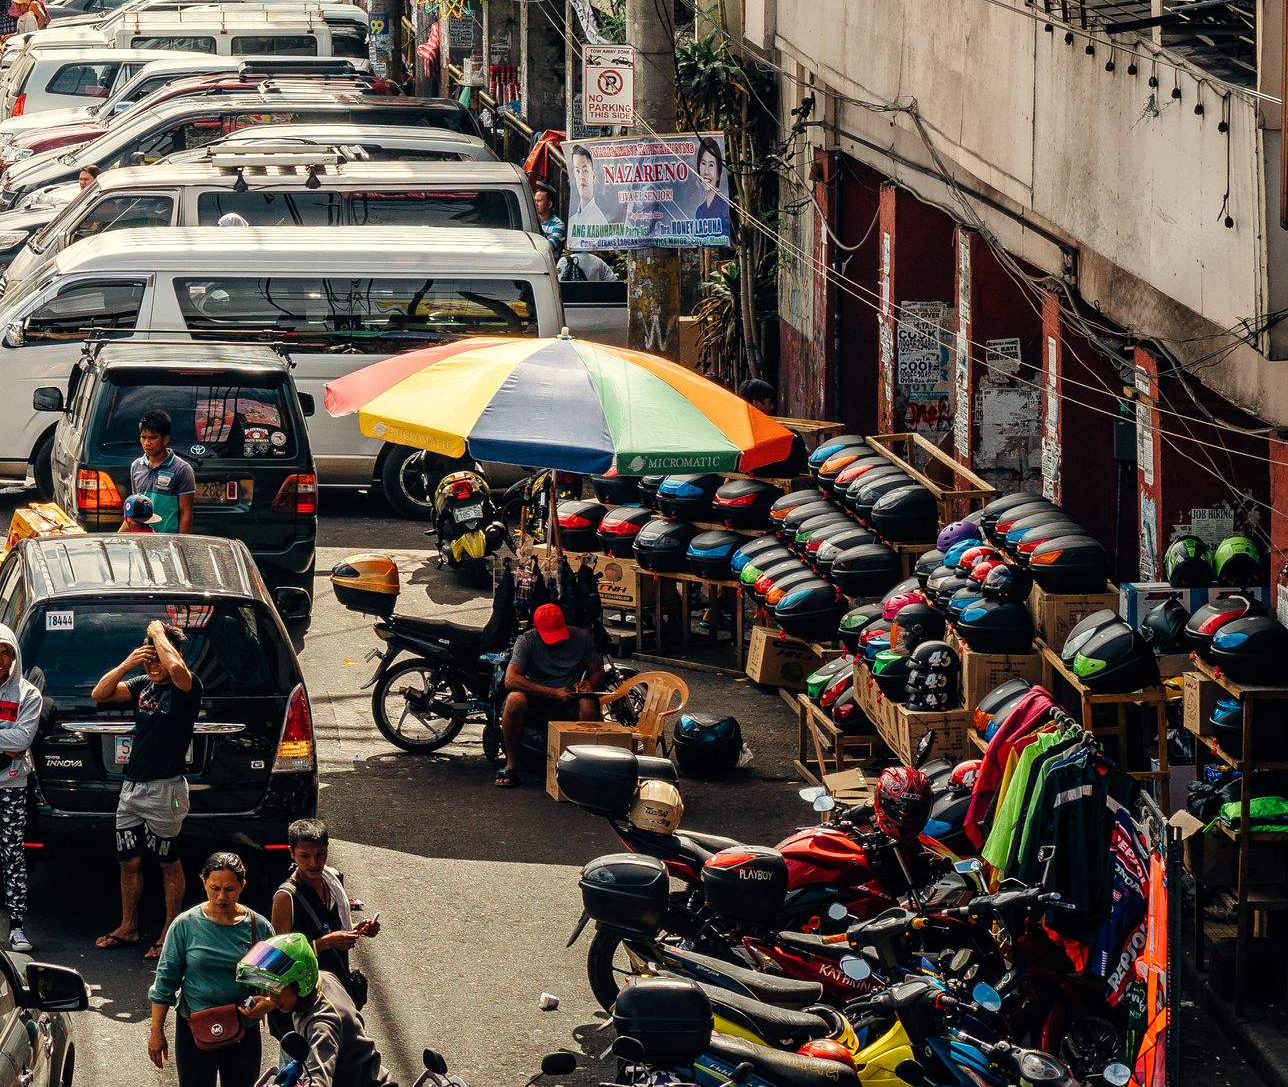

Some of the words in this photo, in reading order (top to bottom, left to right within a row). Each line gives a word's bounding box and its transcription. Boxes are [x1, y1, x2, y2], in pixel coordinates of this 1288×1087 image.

[588, 95, 604, 103] NO
[588, 103, 632, 113] PARKING
[590, 111, 610, 119] THIS
[611, 112, 631, 120] SIDE
[603, 162, 689, 183] NAZARENO
[672, 221, 694, 235] HONEY
[694, 218, 723, 235] LACUNA
[389, 426, 454, 450] MICROMATIC
[647, 456, 721, 470] MICROMATIC
[1192, 509, 1206, 519] JOB
[1207, 509, 1233, 519] HIRING
[739, 869, 773, 881] PLAYBOY
